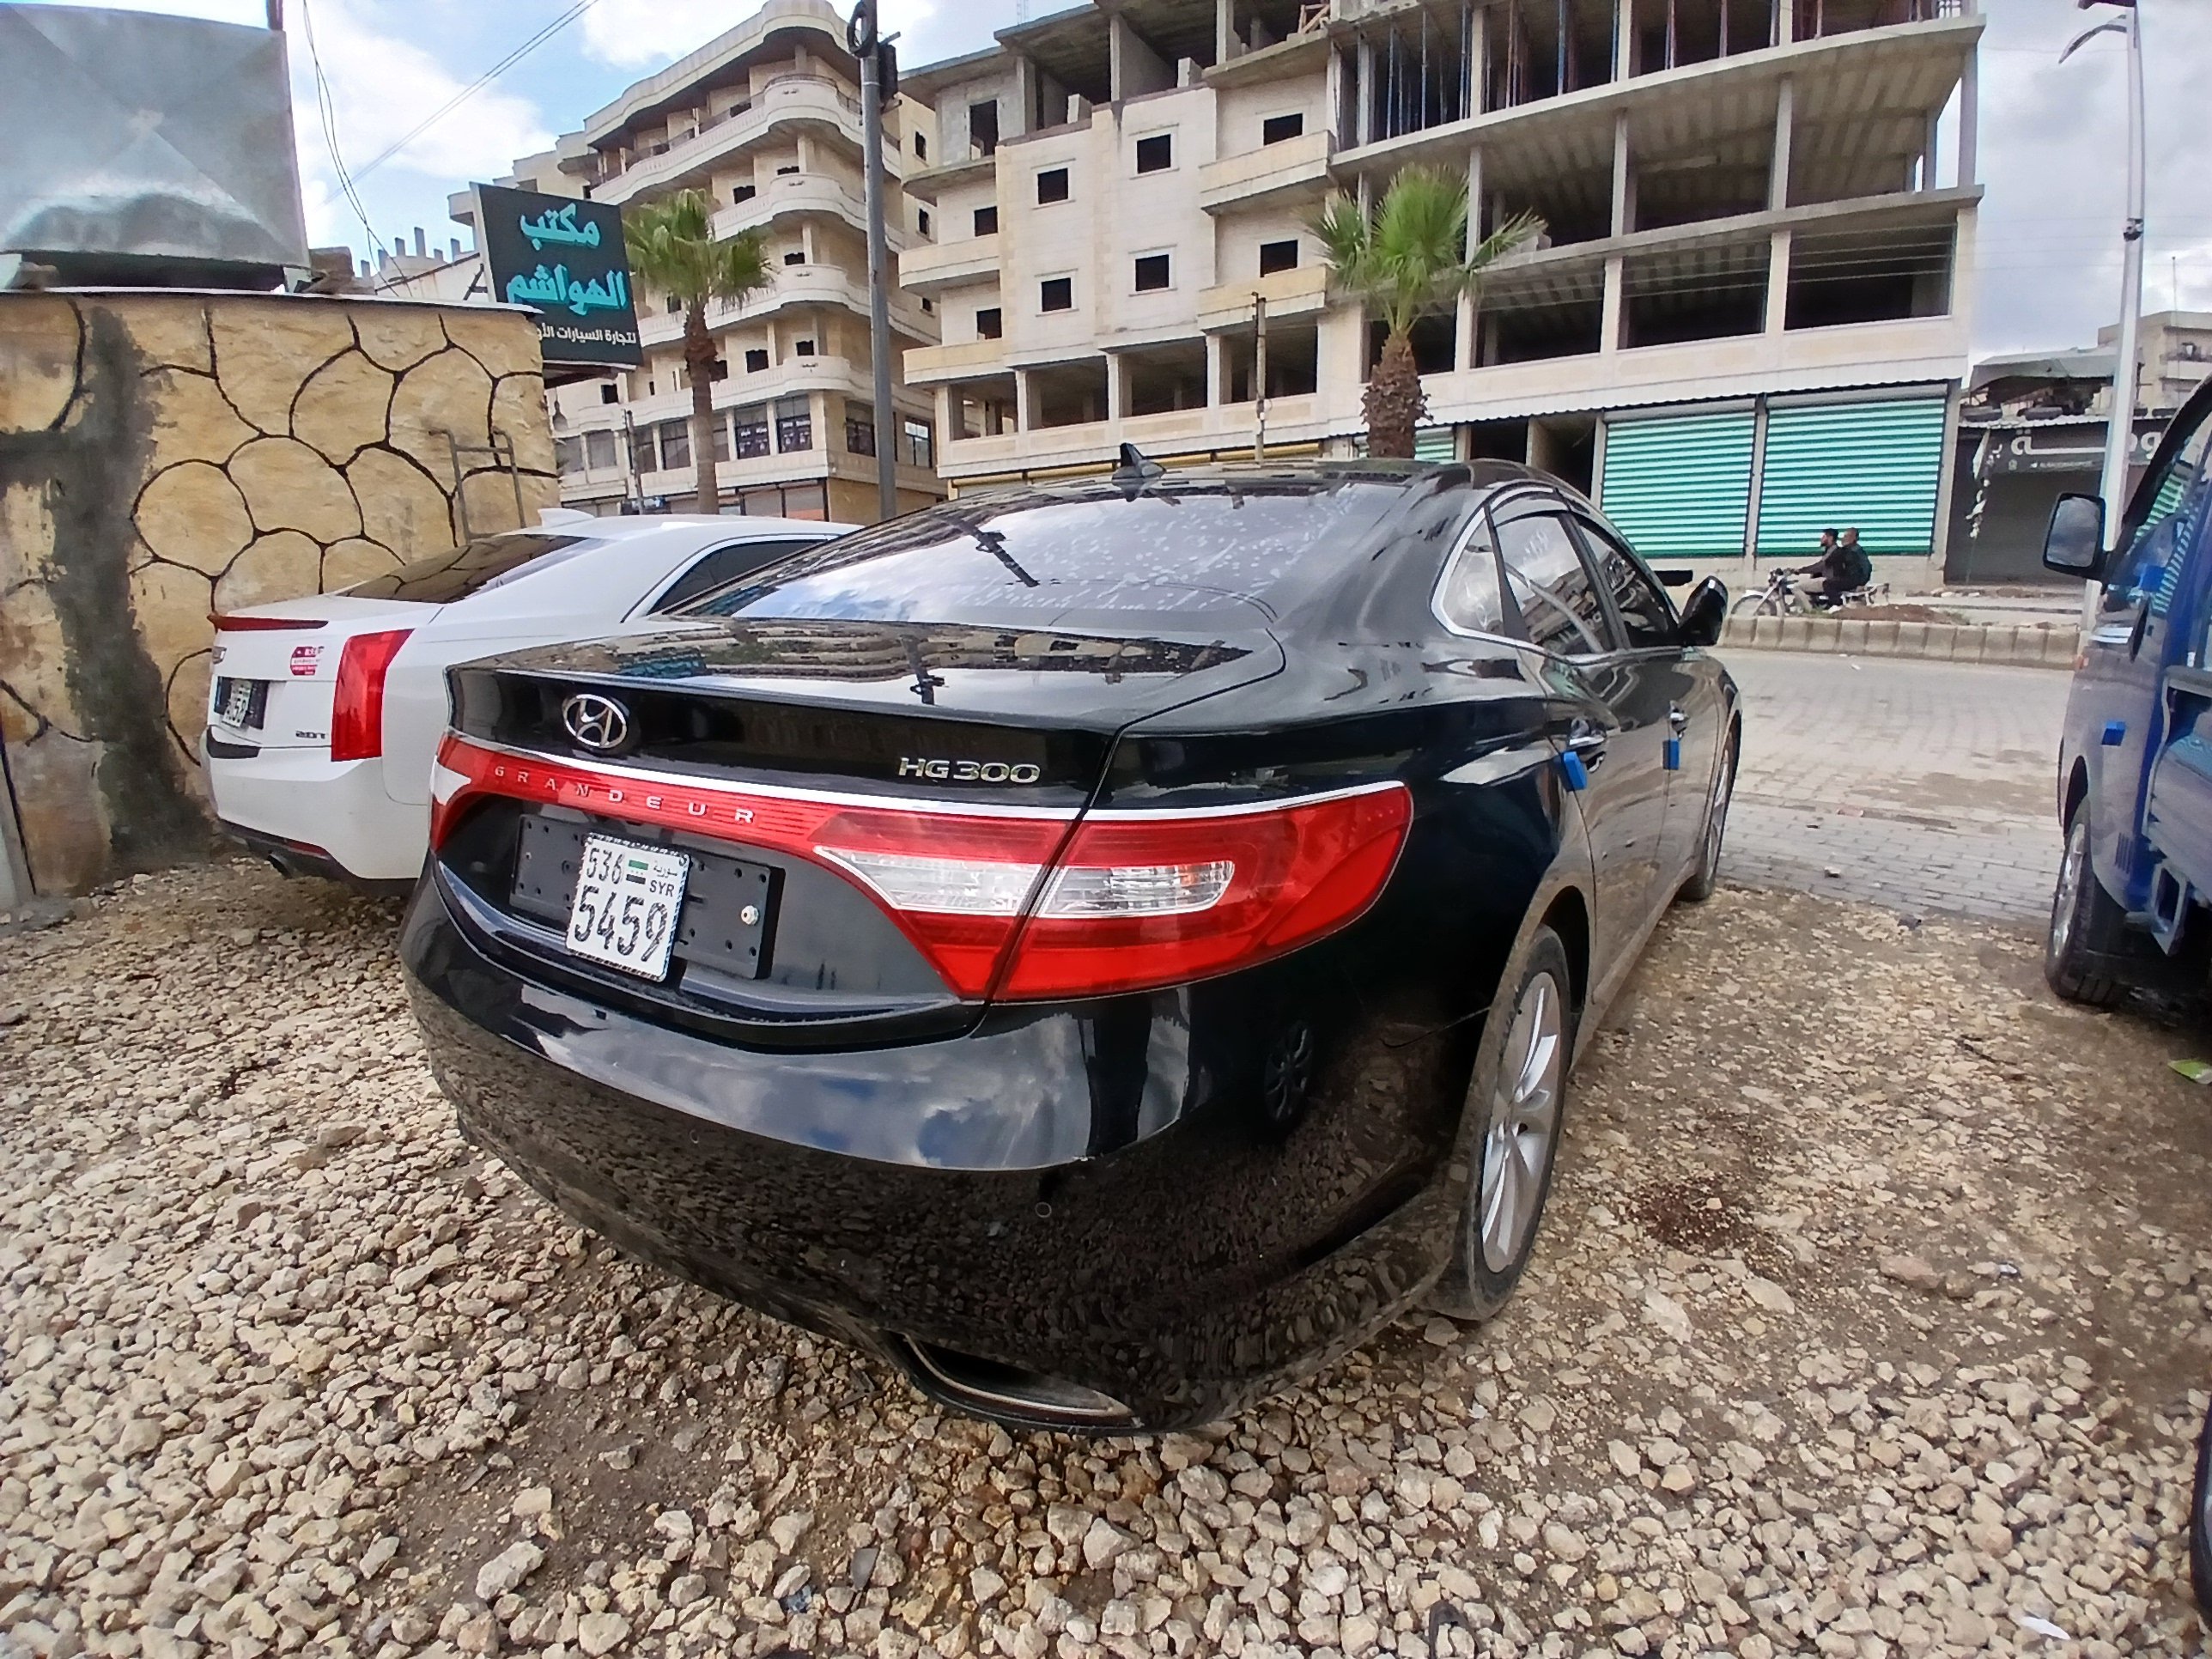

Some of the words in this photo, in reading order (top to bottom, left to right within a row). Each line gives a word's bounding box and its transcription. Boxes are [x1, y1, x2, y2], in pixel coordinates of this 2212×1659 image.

[520, 203, 600, 251] مكتب
[506, 264, 629, 315] الهواشم
[556, 326, 604, 343] السيارات
[605, 329, 637, 346] لتجارة
[494, 765, 755, 824] GRANDEUR
[586, 848, 625, 884] 536
[649, 879, 675, 897] SYR
[574, 884, 669, 963] 5459
